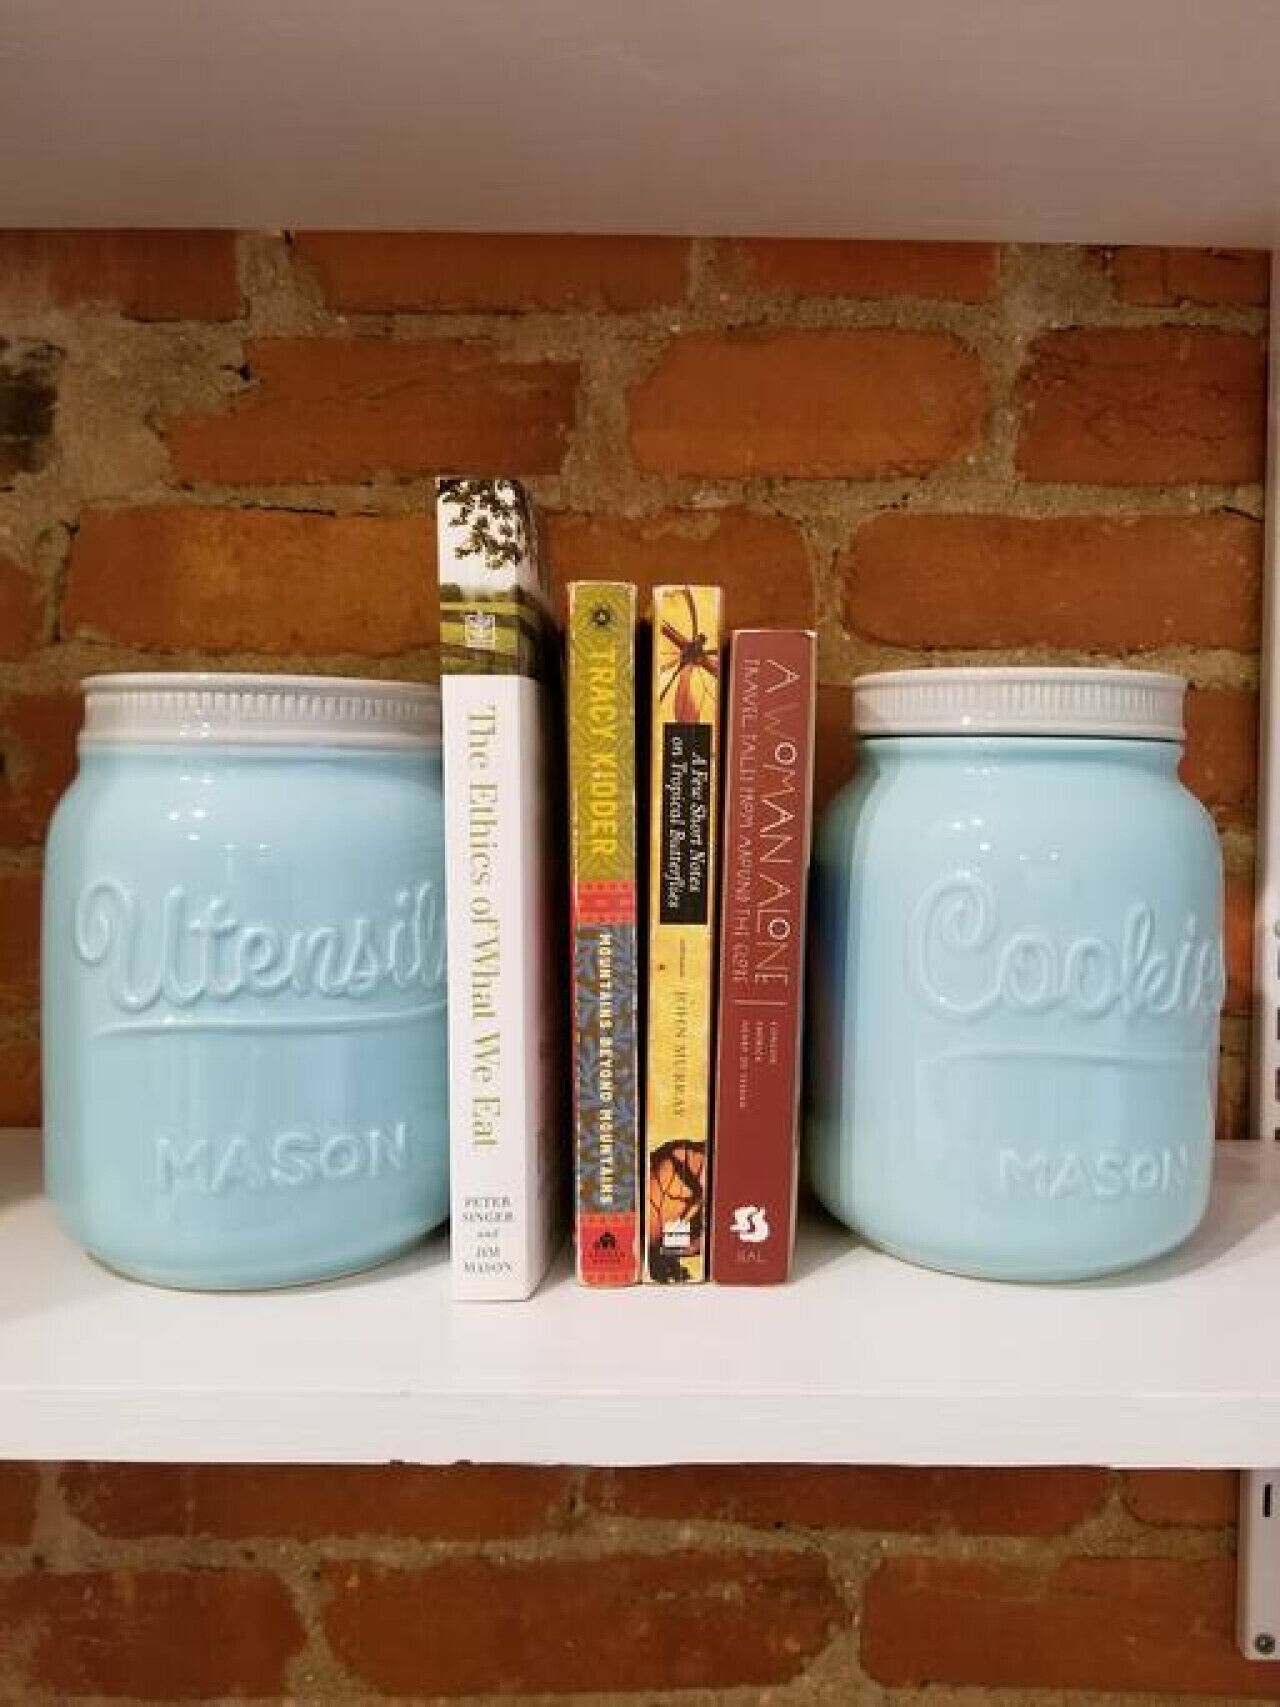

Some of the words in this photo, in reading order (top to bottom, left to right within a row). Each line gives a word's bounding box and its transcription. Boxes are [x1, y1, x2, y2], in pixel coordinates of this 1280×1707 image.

[589, 647, 617, 741] TRACY
[765, 658, 801, 692] A
[467, 700, 497, 769] The
[589, 752, 618, 855] KIDDER
[665, 761, 688, 825] Tropical
[758, 701, 798, 862] WOMAN
[469, 784, 499, 885] Ethics
[690, 803, 707, 846] Short
[689, 849, 706, 894] Notes
[75, 880, 444, 1012] Utensil
[470, 896, 500, 932] of
[754, 874, 791, 985] ALONE
[470, 934, 501, 1019] What
[600, 934, 612, 1029] MOUNTAINS
[471, 1031, 501, 1083] We
[600, 1036, 614, 1102] BEYOND
[471, 1096, 501, 1147] Eat
[600, 1109, 614, 1203] MOUNTAINS
[155, 1122, 408, 1194] MASON
[999, 1143, 1192, 1201] MASON
